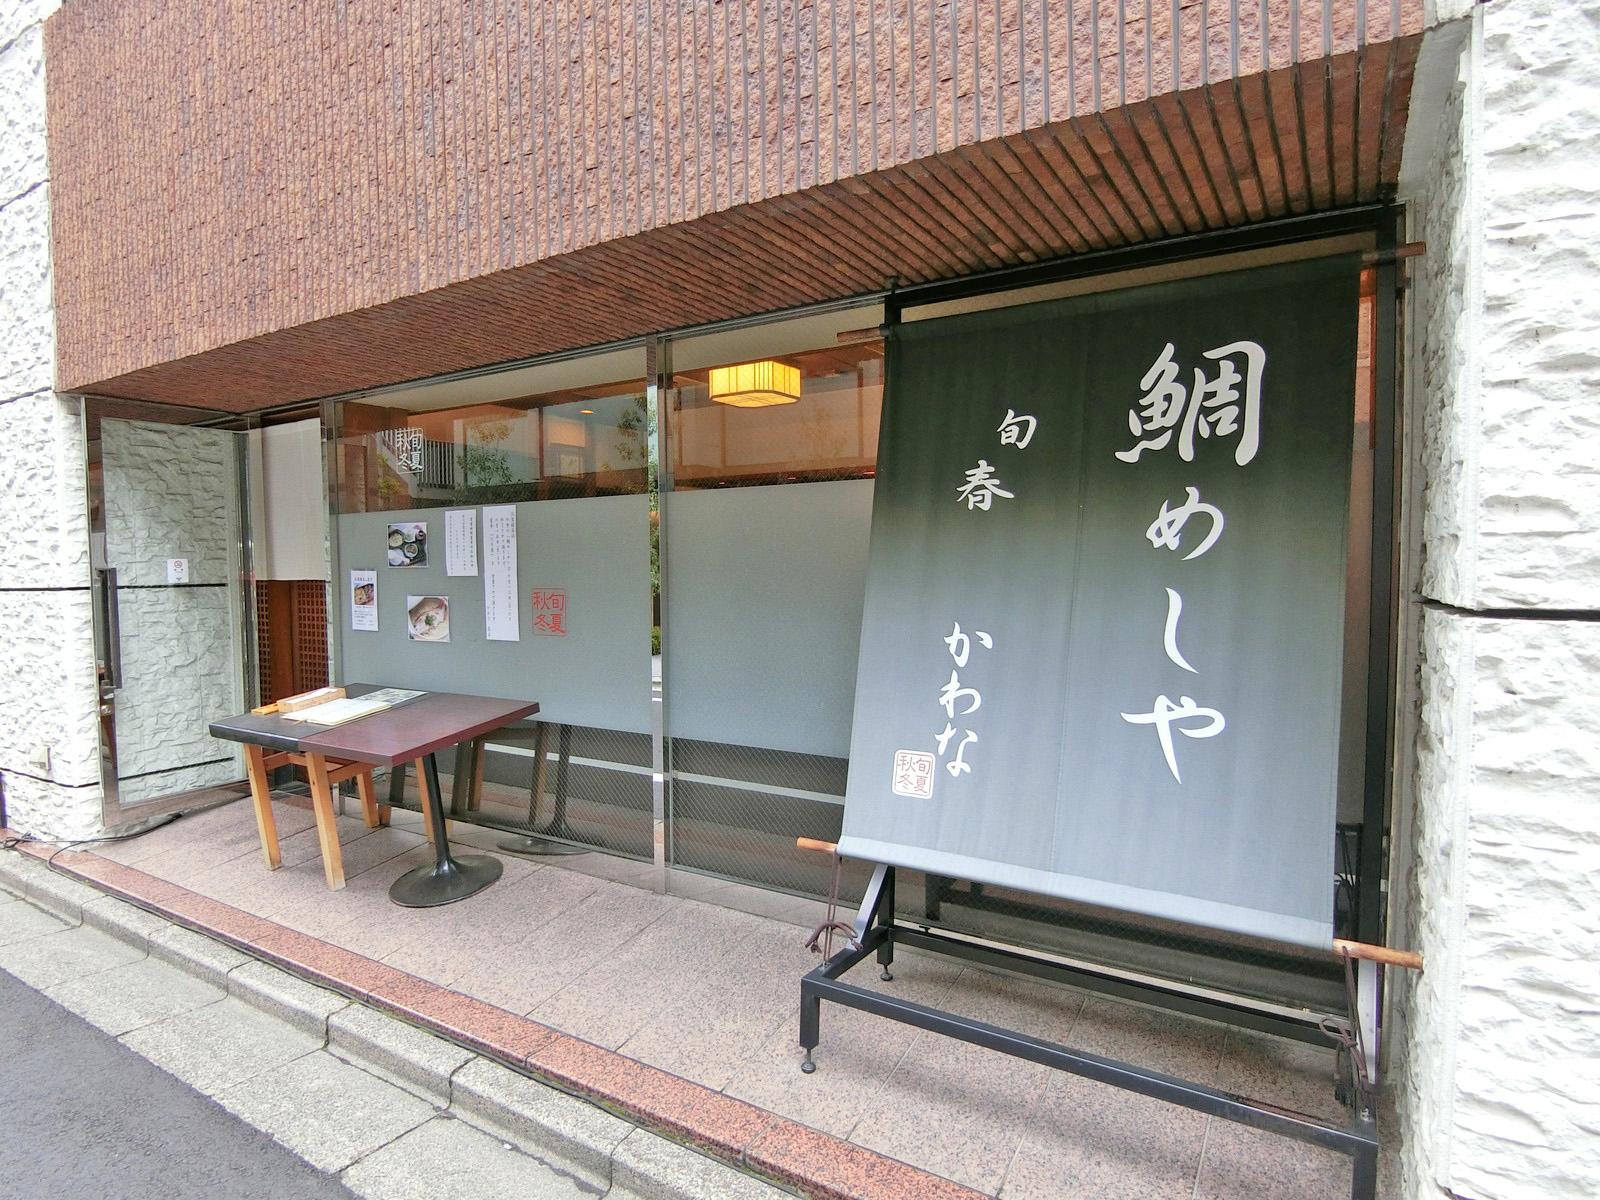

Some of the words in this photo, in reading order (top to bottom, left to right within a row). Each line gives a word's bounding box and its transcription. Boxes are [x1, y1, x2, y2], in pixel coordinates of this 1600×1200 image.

[935, 621, 993, 777] かわな
[1114, 340, 1267, 785] 鯛めしや
